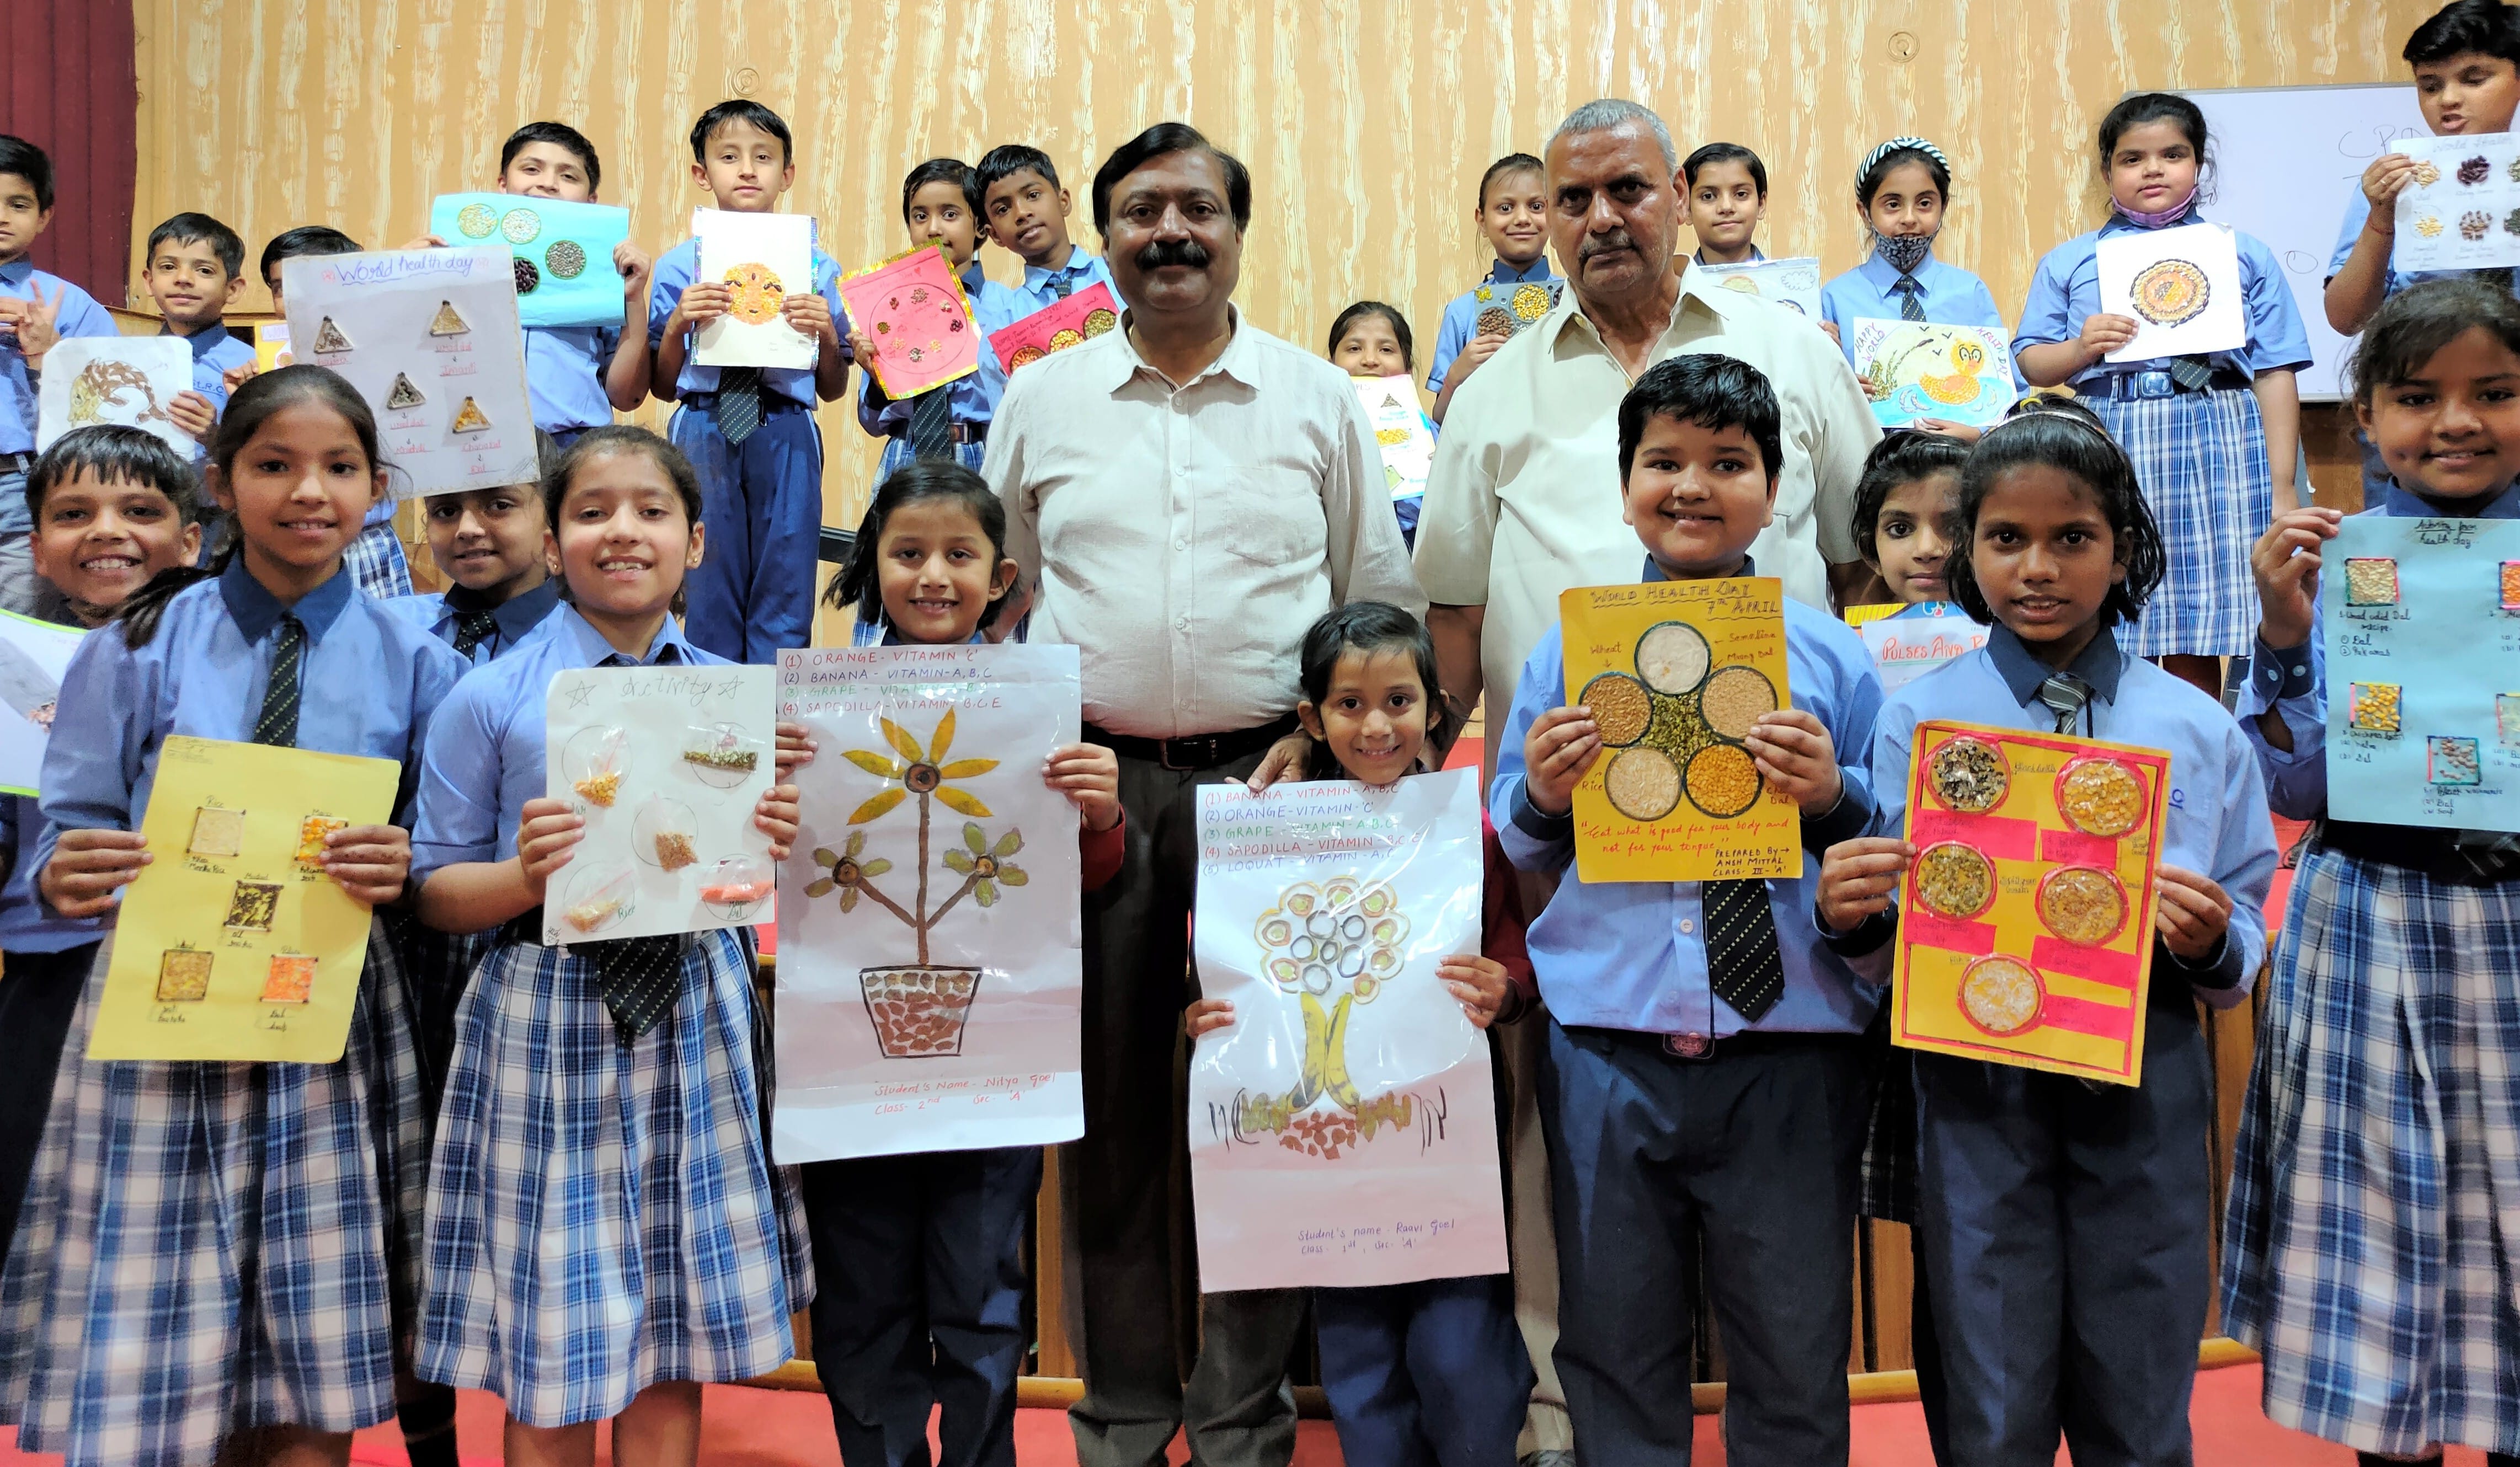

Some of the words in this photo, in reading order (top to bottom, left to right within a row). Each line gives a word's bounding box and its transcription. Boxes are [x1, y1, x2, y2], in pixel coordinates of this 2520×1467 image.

[444, 255, 474, 277] day
[1855, 322, 1878, 354] HAPPY
[1862, 330, 1886, 363] WORLD
[1976, 327, 2006, 355] HEALTH
[1998, 356, 2009, 377] DAY
[1589, 589, 1637, 602] WORLD
[1645, 583, 1710, 599] HEALTH
[1715, 580, 1751, 597] DAY
[1731, 600, 1780, 614] APRIL
[1590, 643, 1622, 655] Wheat
[1882, 636, 1928, 661] PULSES
[784, 653, 802, 669] (1)
[893, 650, 956, 662] VITAMIN
[784, 671, 799, 685] (2)
[810, 668, 868, 683] BANANA
[809, 684, 857, 697] GRAPE
[782, 702, 799, 716] (4)
[1582, 780, 1603, 792] Rice
[1205, 793, 1221, 809] (1)
[1225, 789, 1284, 802] BANANA
[1205, 809, 1220, 824] (2)
[1225, 826, 1273, 840] GRAPE
[1204, 845, 1220, 859] (4)
[1227, 840, 1301, 856] SAPODILLA
[1318, 837, 1373, 850] VITAMIN
[1602, 842, 1619, 853] not
[1715, 848, 1761, 858] PREPARED
[1202, 864, 1219, 876] (5)
[1227, 858, 1283, 872] LOQUAT
[1716, 858, 1743, 867] ANSH
[1747, 858, 1784, 866] MITTAL
[875, 1082, 931, 1097] Student's
[936, 1080, 969, 1090] Name
[1298, 1227, 1346, 1241] Student's
[1353, 1226, 1382, 1236] name
[1396, 1220, 1423, 1235] Raavi
